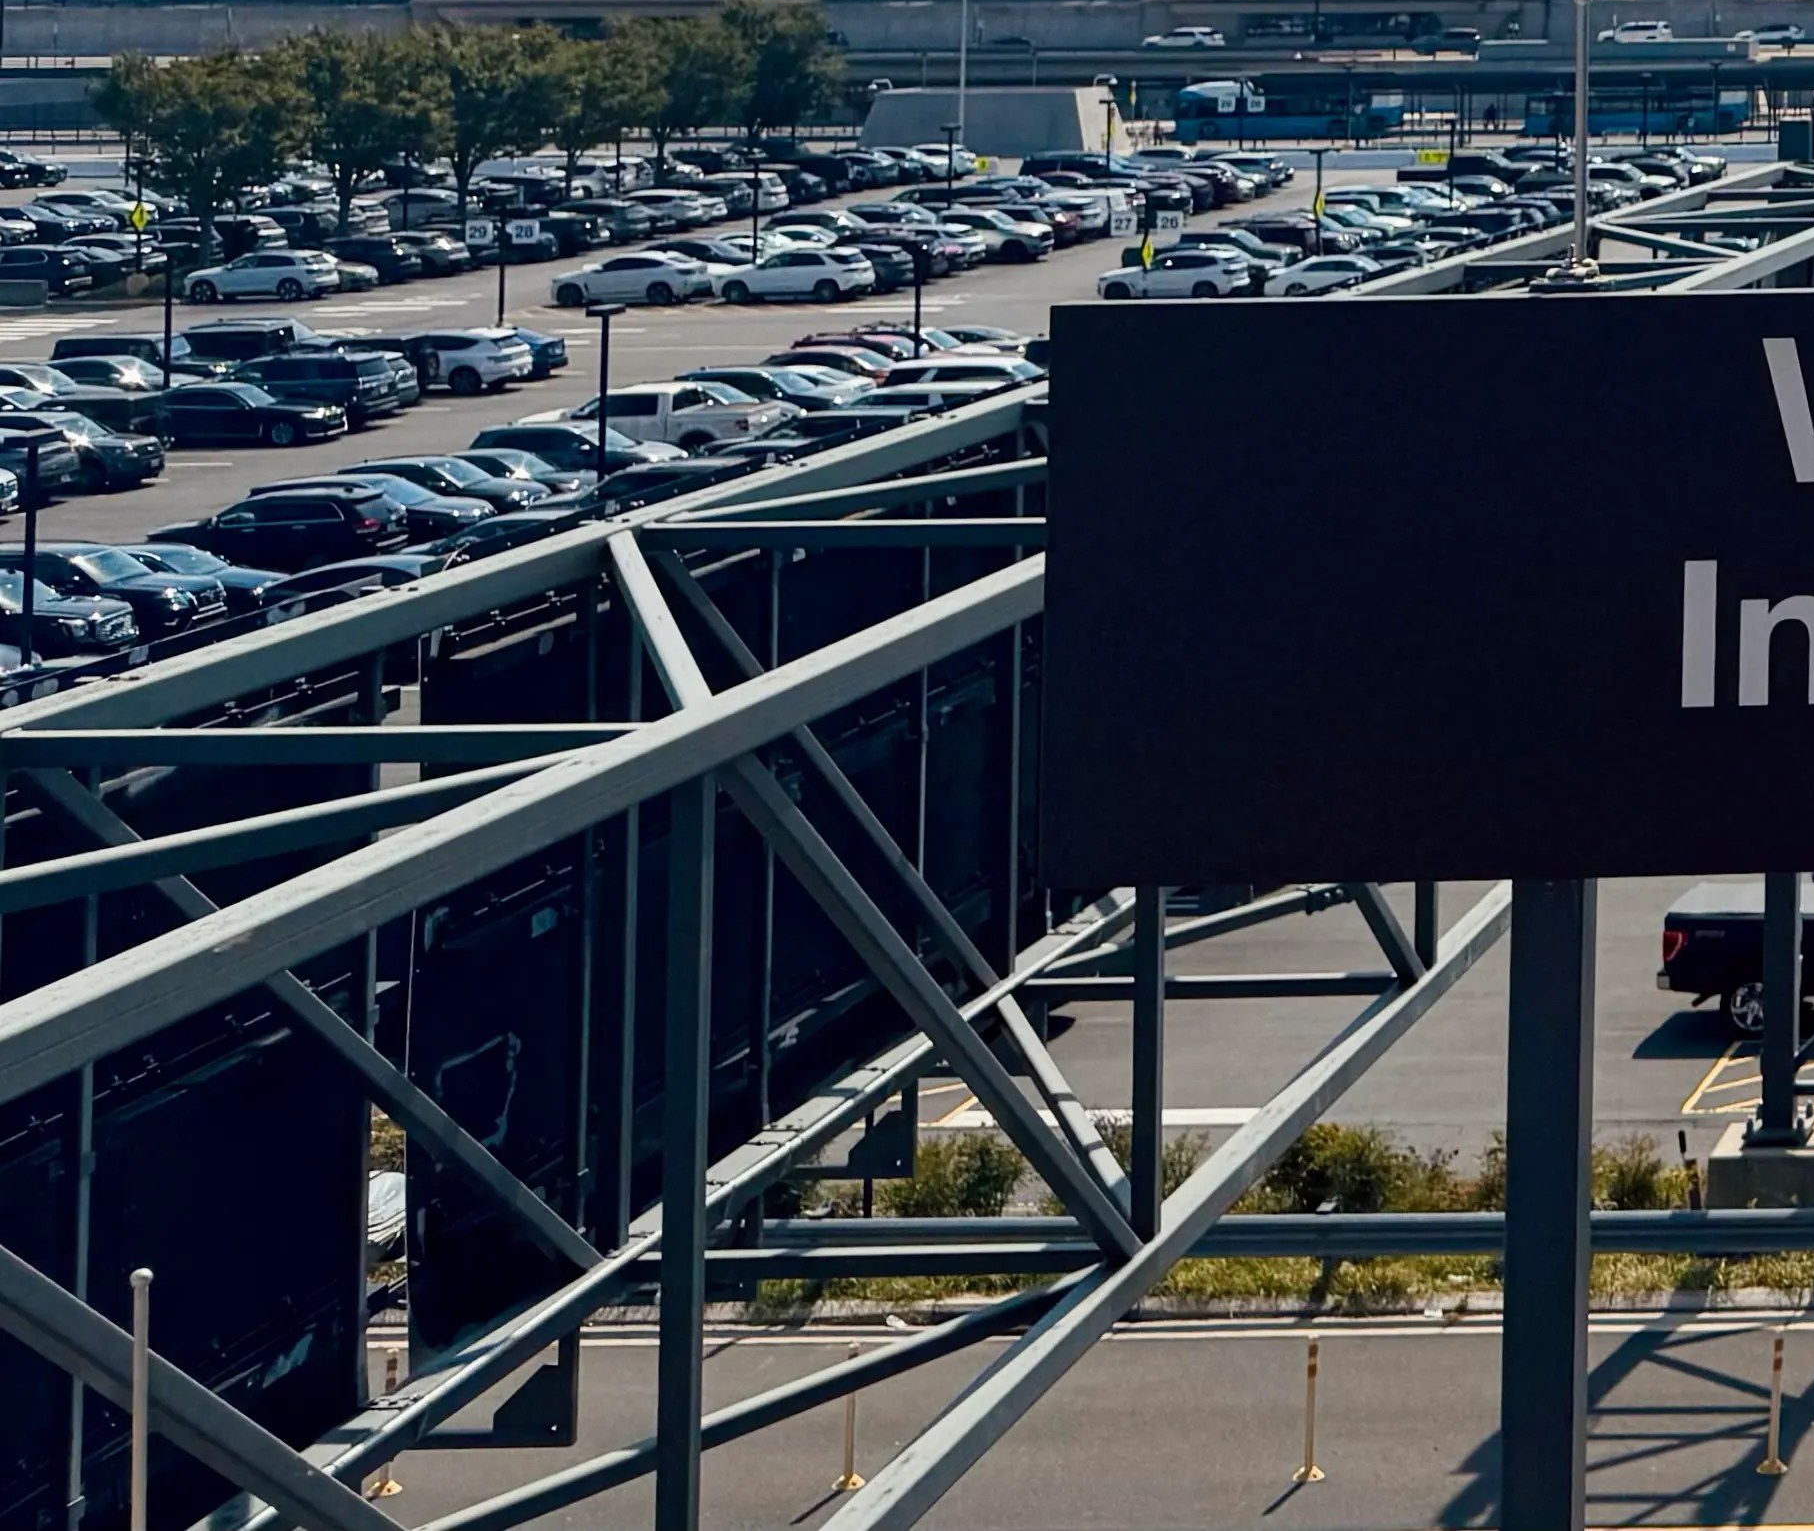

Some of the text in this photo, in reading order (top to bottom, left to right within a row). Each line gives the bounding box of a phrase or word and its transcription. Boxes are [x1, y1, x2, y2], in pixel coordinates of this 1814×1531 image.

[1114, 217, 1132, 231] 27
[1160, 216, 1179, 229] 26
[468, 225, 488, 239] 29
[515, 225, 534, 239] 28
